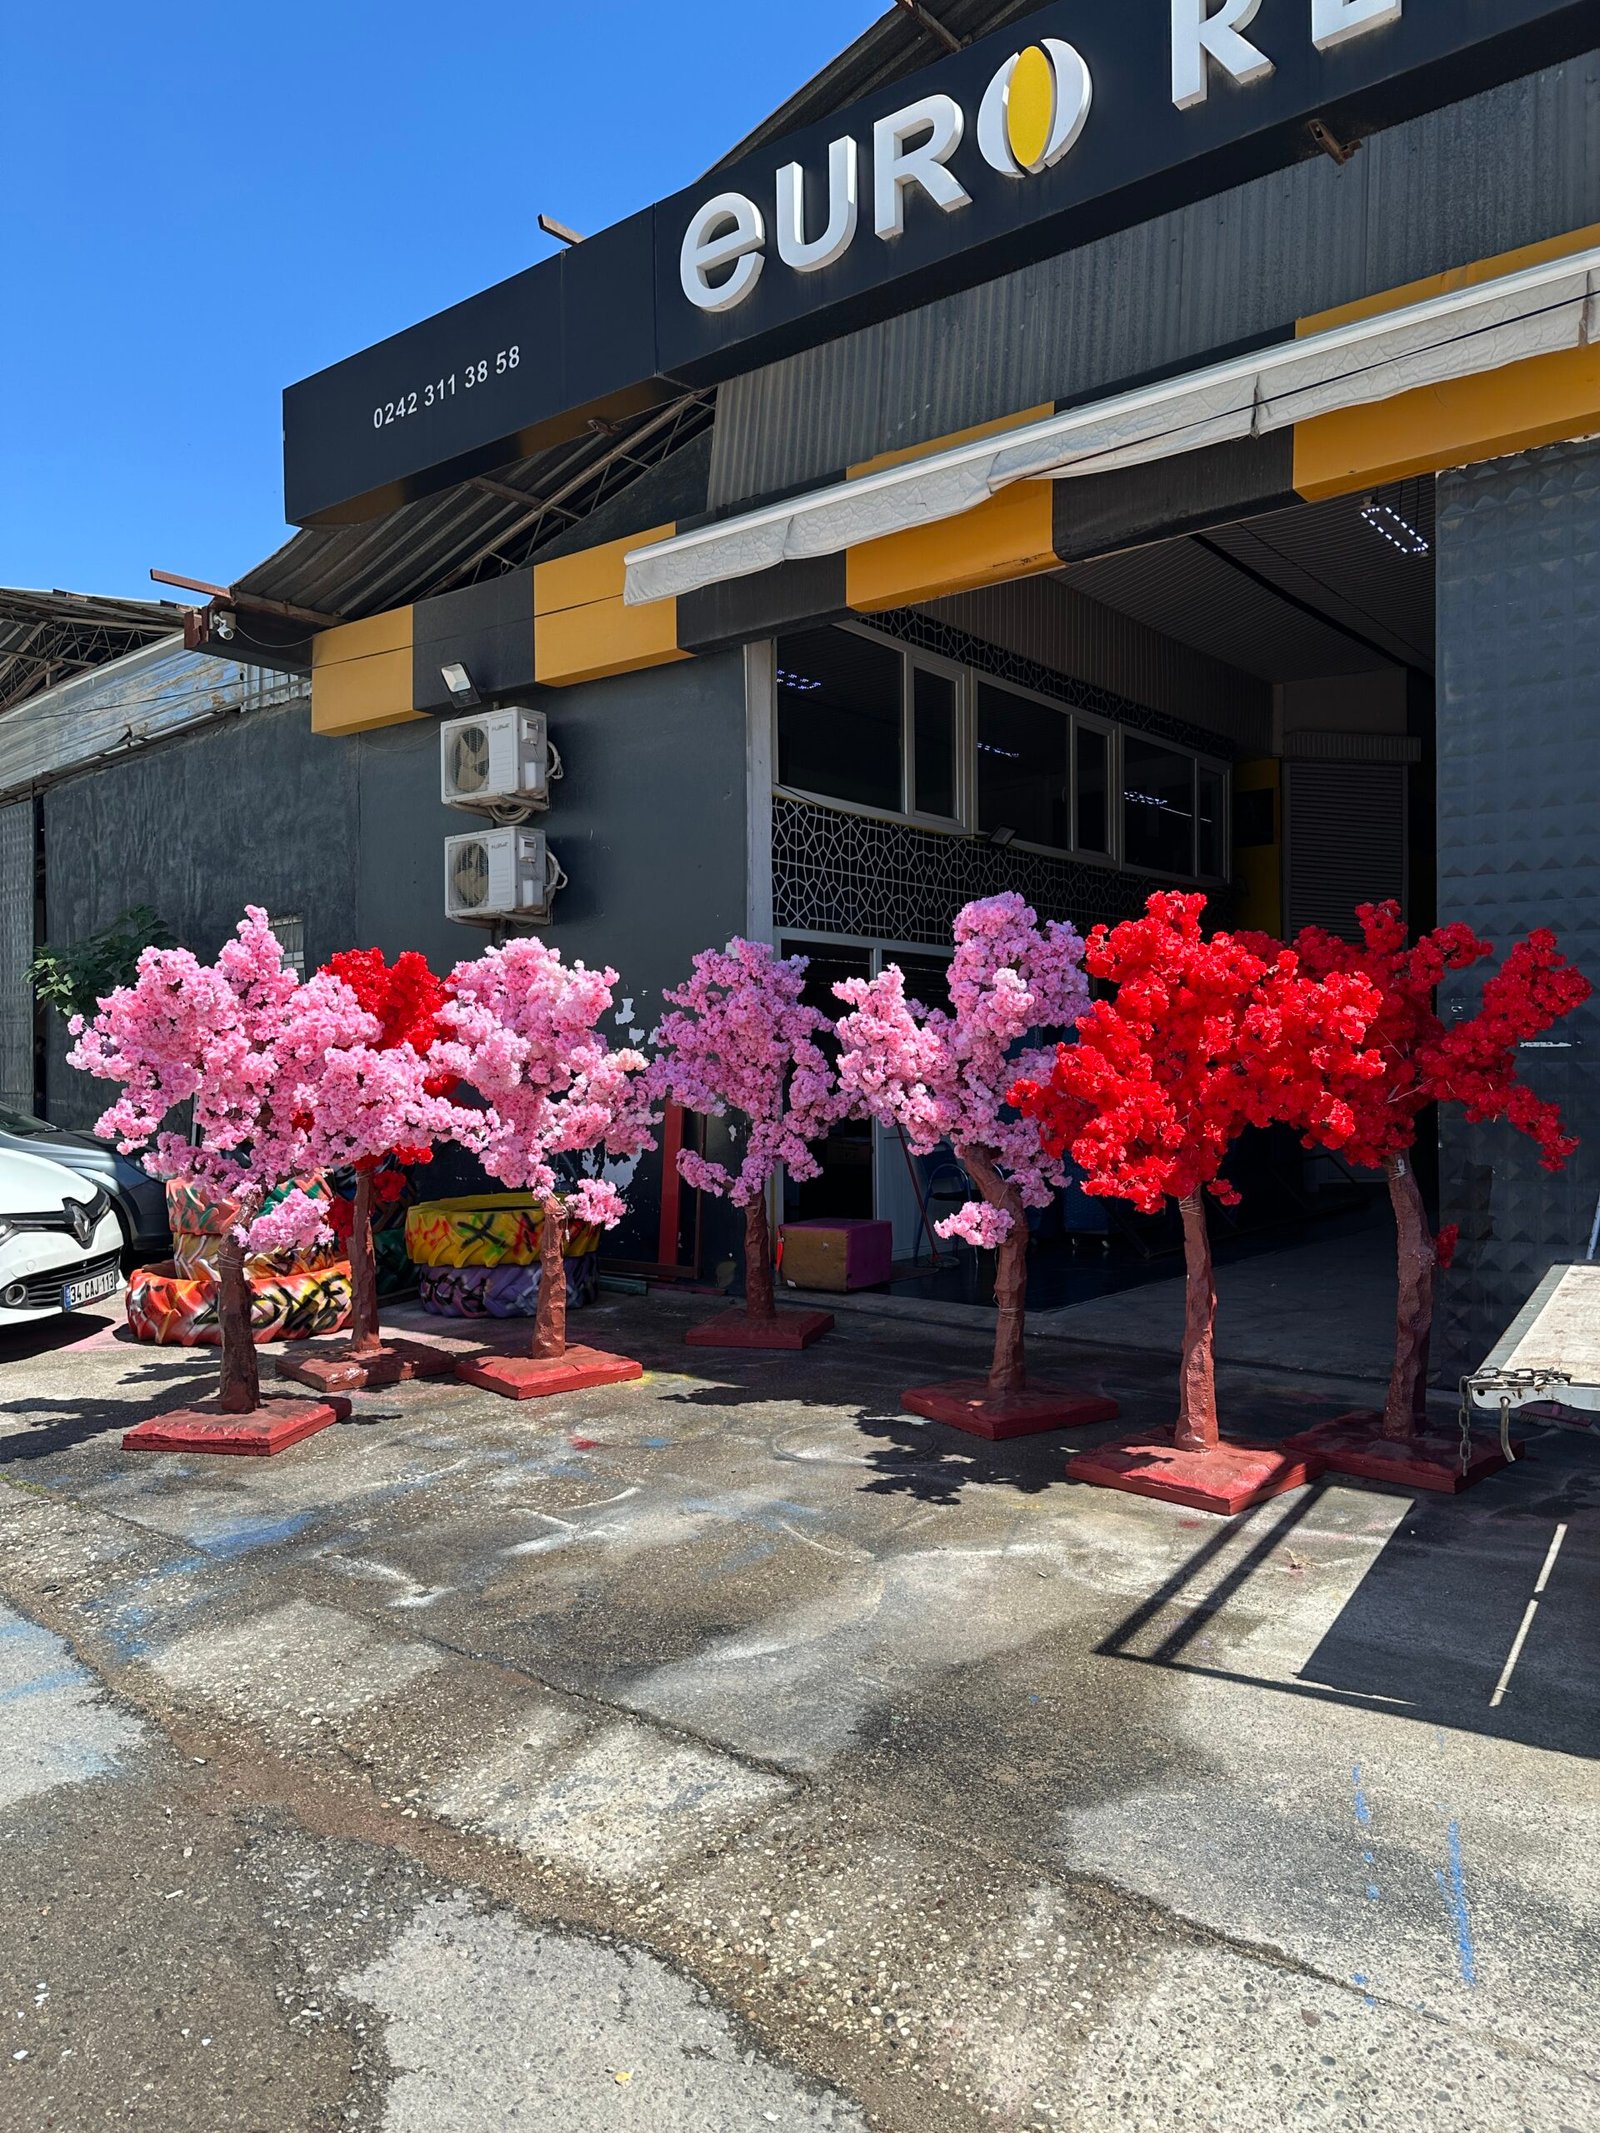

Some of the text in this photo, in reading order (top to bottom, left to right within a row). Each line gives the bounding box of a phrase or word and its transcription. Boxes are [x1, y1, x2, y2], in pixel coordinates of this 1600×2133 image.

[1171, 0, 1402, 110] R
[373, 345, 520, 429] 0242 311 38 58
[71, 1285, 81, 1303] 34
